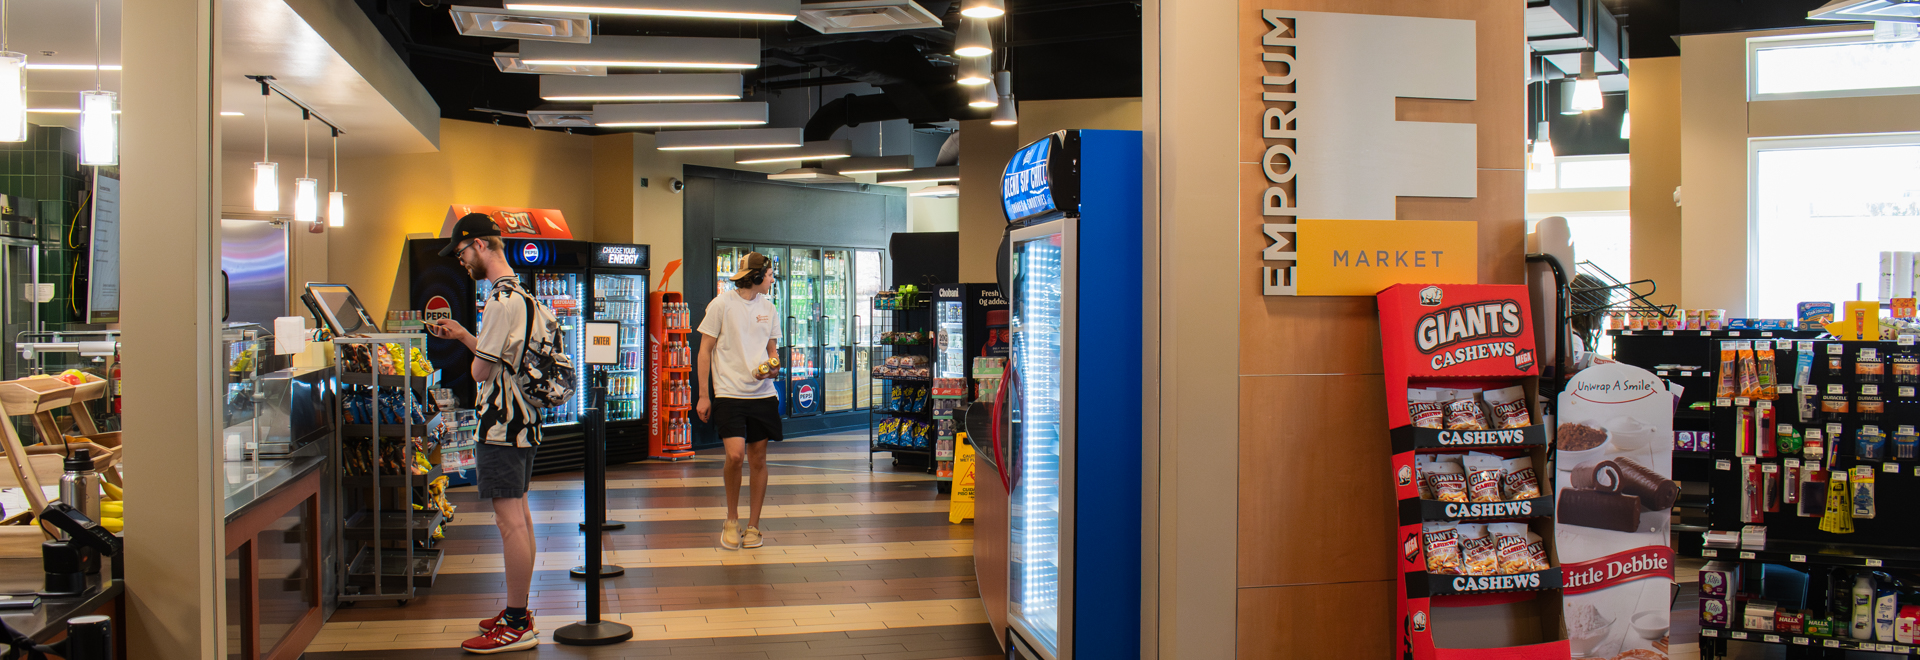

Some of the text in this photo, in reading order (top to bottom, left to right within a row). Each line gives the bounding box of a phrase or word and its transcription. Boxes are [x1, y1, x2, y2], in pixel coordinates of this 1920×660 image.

[1262, 9, 1297, 296] EMPORIUM
[602, 246, 624, 254] CHOOSE
[608, 253, 639, 264] ENERGY
[1333, 250, 1443, 267] MARKET
[939, 288, 959, 297] Chobani
[426, 312, 450, 320] PEPSI
[1417, 303, 1520, 350] GIANTS
[593, 336, 610, 345] ENTER
[1431, 342, 1515, 370] CASHEWS
[1515, 353, 1532, 365] MEGA
[1577, 379, 1650, 394] Unwrap A Smile
[1409, 403, 1441, 416] GIANTS
[1495, 399, 1526, 416] GIANTS
[1437, 430, 1524, 445] CASHEWS
[1445, 501, 1532, 518] CASHEWS
[1423, 529, 1459, 545] GIANTS
[1606, 553, 1668, 580] Debbie
[1453, 573, 1540, 591] CASHEWS
[1779, 616, 1799, 624] HALLS
